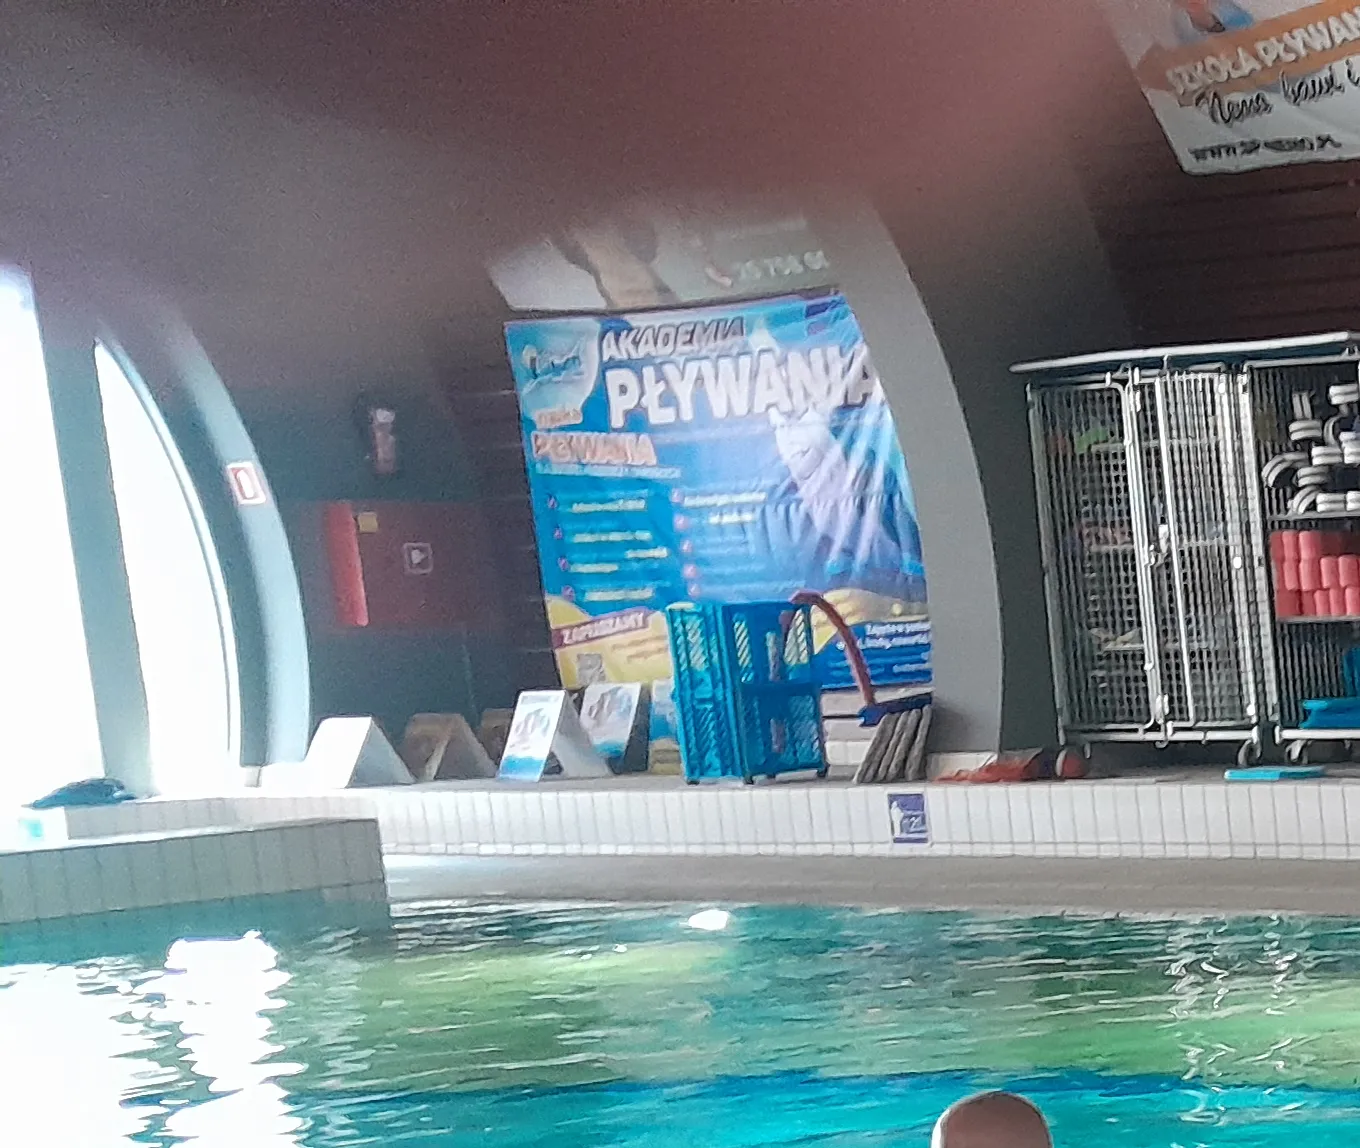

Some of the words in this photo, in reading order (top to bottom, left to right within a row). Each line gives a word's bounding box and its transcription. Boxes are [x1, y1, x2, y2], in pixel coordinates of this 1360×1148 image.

[1166, 46, 1261, 97] SZKOŁA
[601, 315, 745, 361] AKADEMIA
[604, 342, 882, 429] PŁYWANIA
